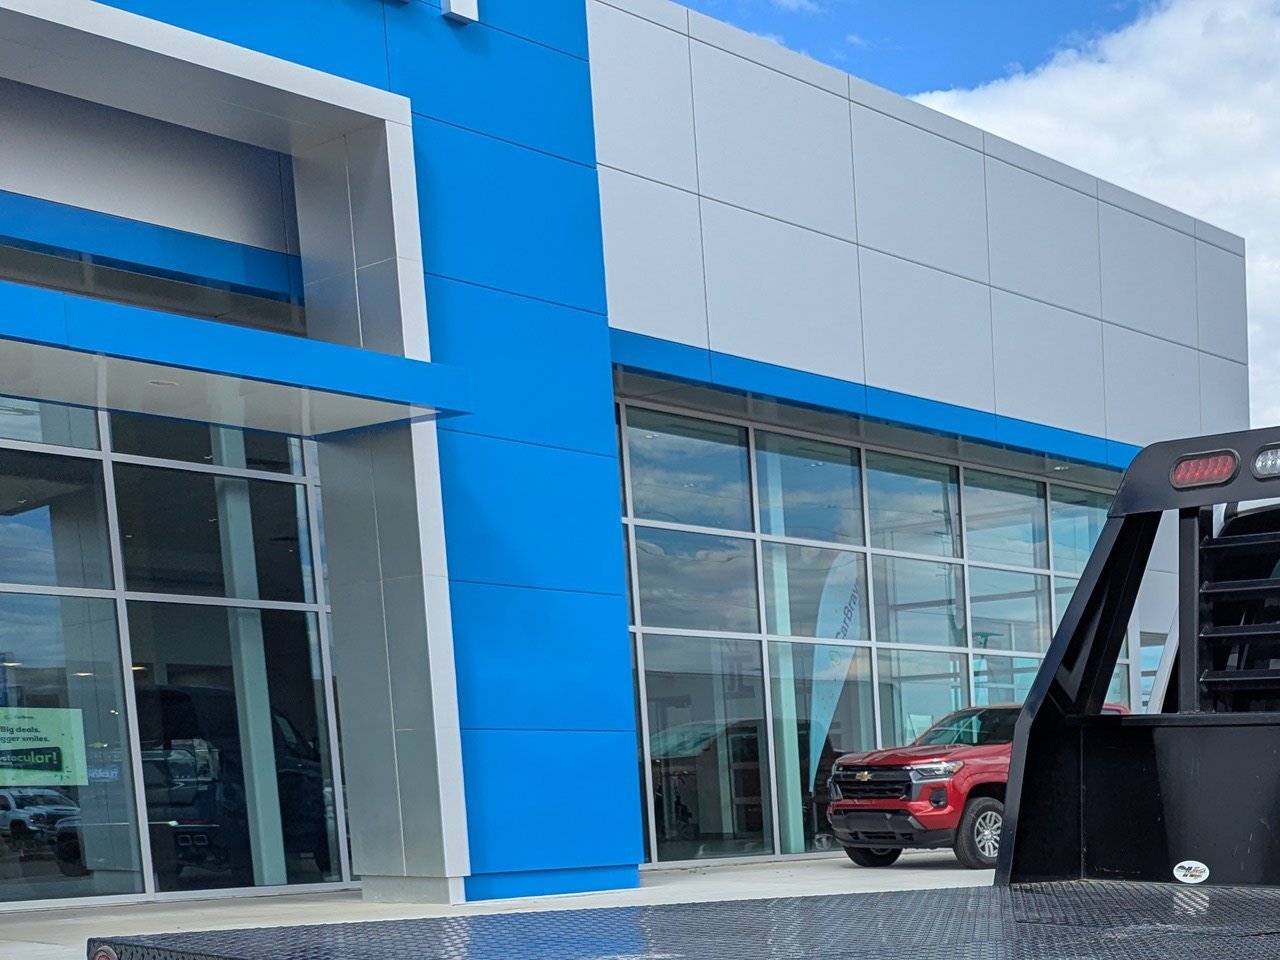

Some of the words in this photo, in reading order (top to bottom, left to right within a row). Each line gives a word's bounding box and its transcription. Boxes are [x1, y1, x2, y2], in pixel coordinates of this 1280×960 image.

[835, 582, 860, 639] CarBrav
[15, 726, 41, 734] deals.
[21, 735, 50, 743] smiles.
